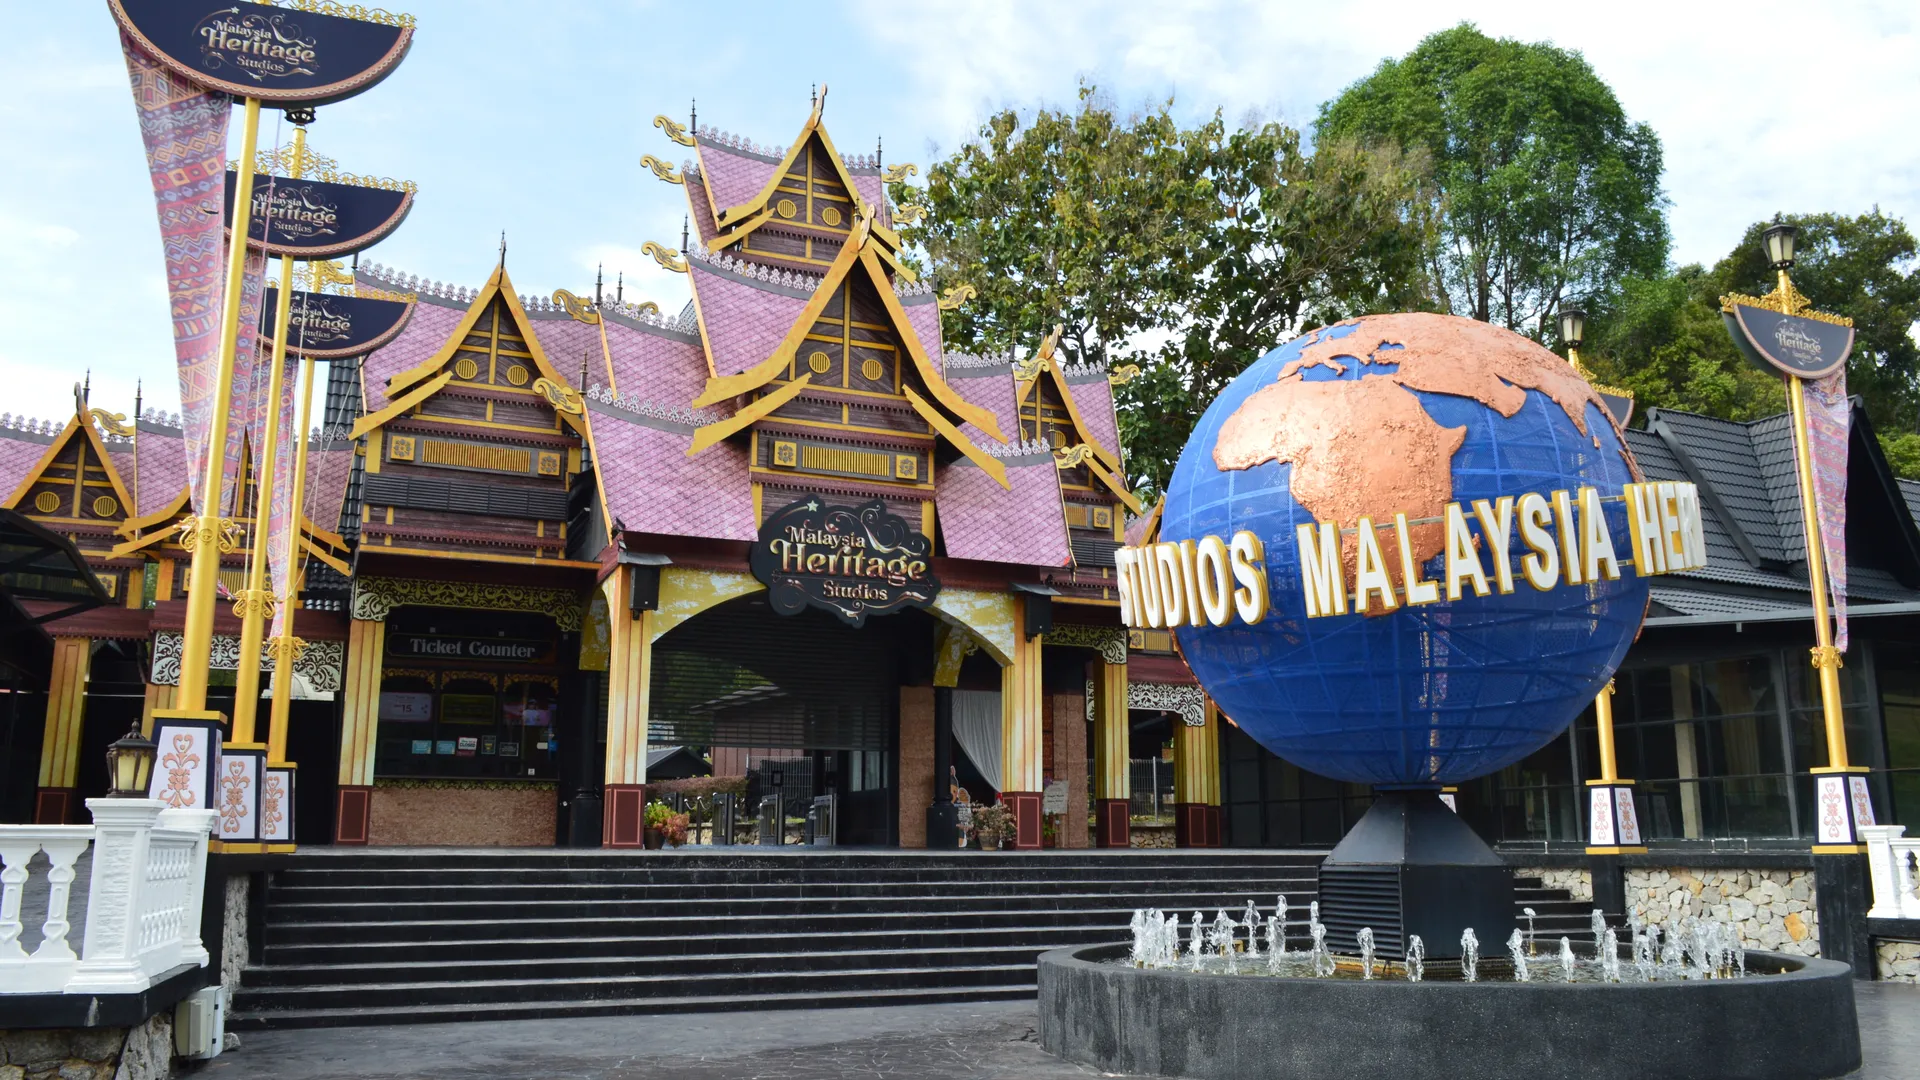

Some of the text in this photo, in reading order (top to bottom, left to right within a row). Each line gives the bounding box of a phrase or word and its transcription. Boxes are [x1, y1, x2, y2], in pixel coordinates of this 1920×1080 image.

[212, 20, 272, 39] Malaysia
[201, 27, 316, 65] Heritage
[236, 55, 285, 73] Studios
[251, 199, 337, 227] Heritage
[274, 220, 312, 233] Studios
[289, 305, 322, 317] alaysia
[1775, 332, 1821, 355] Heritage
[784, 526, 866, 549] Malaysia
[770, 538, 927, 587] Heritage
[1114, 530, 1269, 629] STUDIOS
[1296, 486, 1621, 618] MALAYSIA
[823, 579, 889, 601] Studios
[410, 638, 536, 658] Ticket Counter
